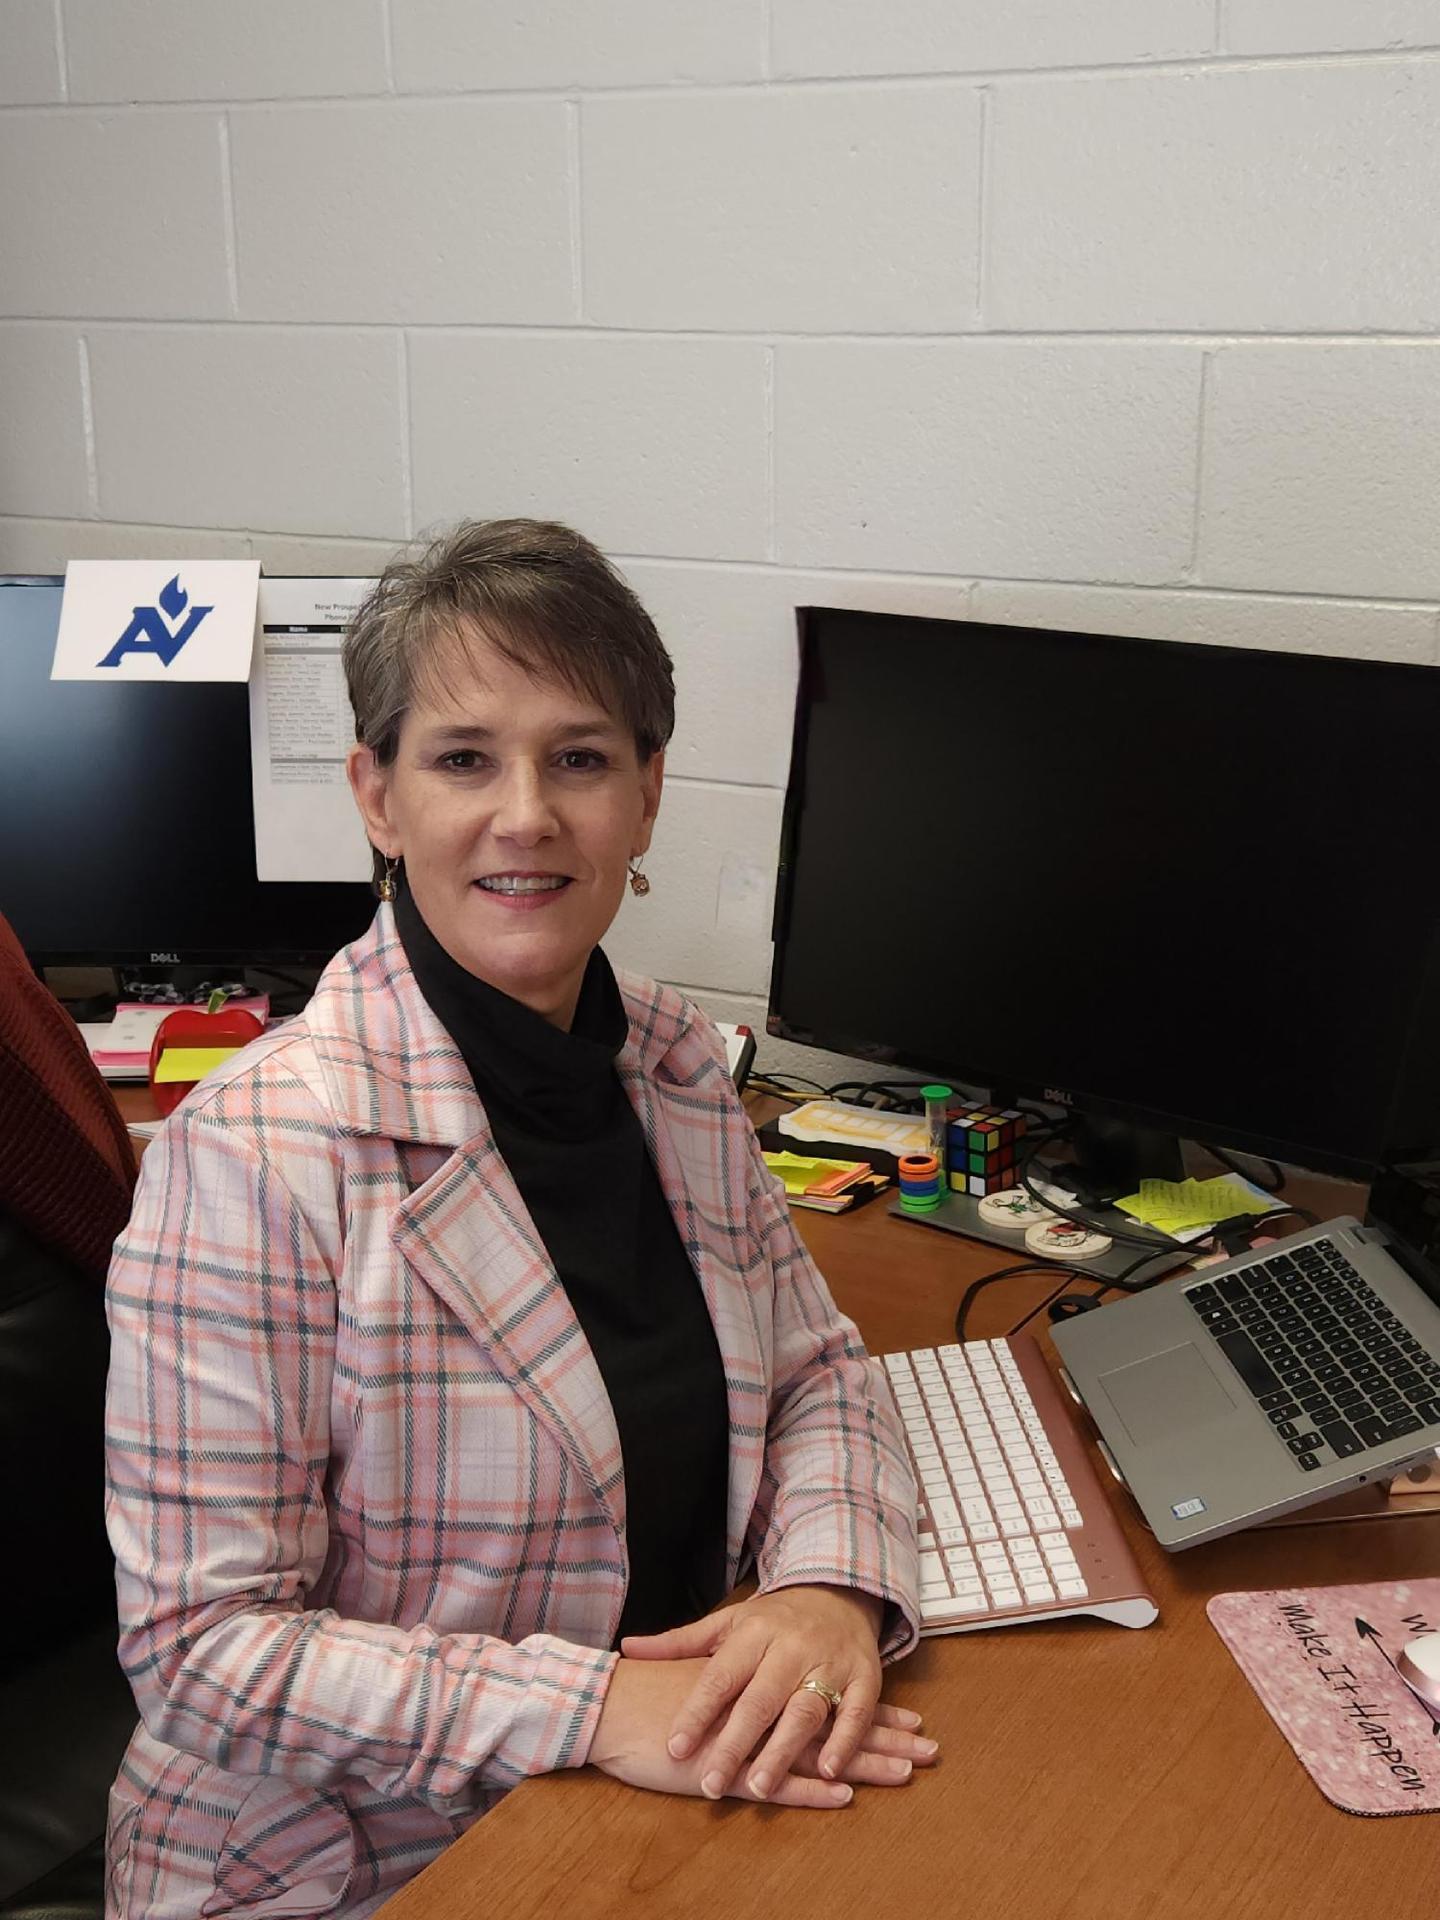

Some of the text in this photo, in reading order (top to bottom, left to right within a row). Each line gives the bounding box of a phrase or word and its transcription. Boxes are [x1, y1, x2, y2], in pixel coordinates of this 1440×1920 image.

[95, 605, 214, 668] AV
[151, 953, 181, 964] DELL
[1043, 1088, 1073, 1105] DELL
[1278, 1604, 1426, 1791] Make It Happen
